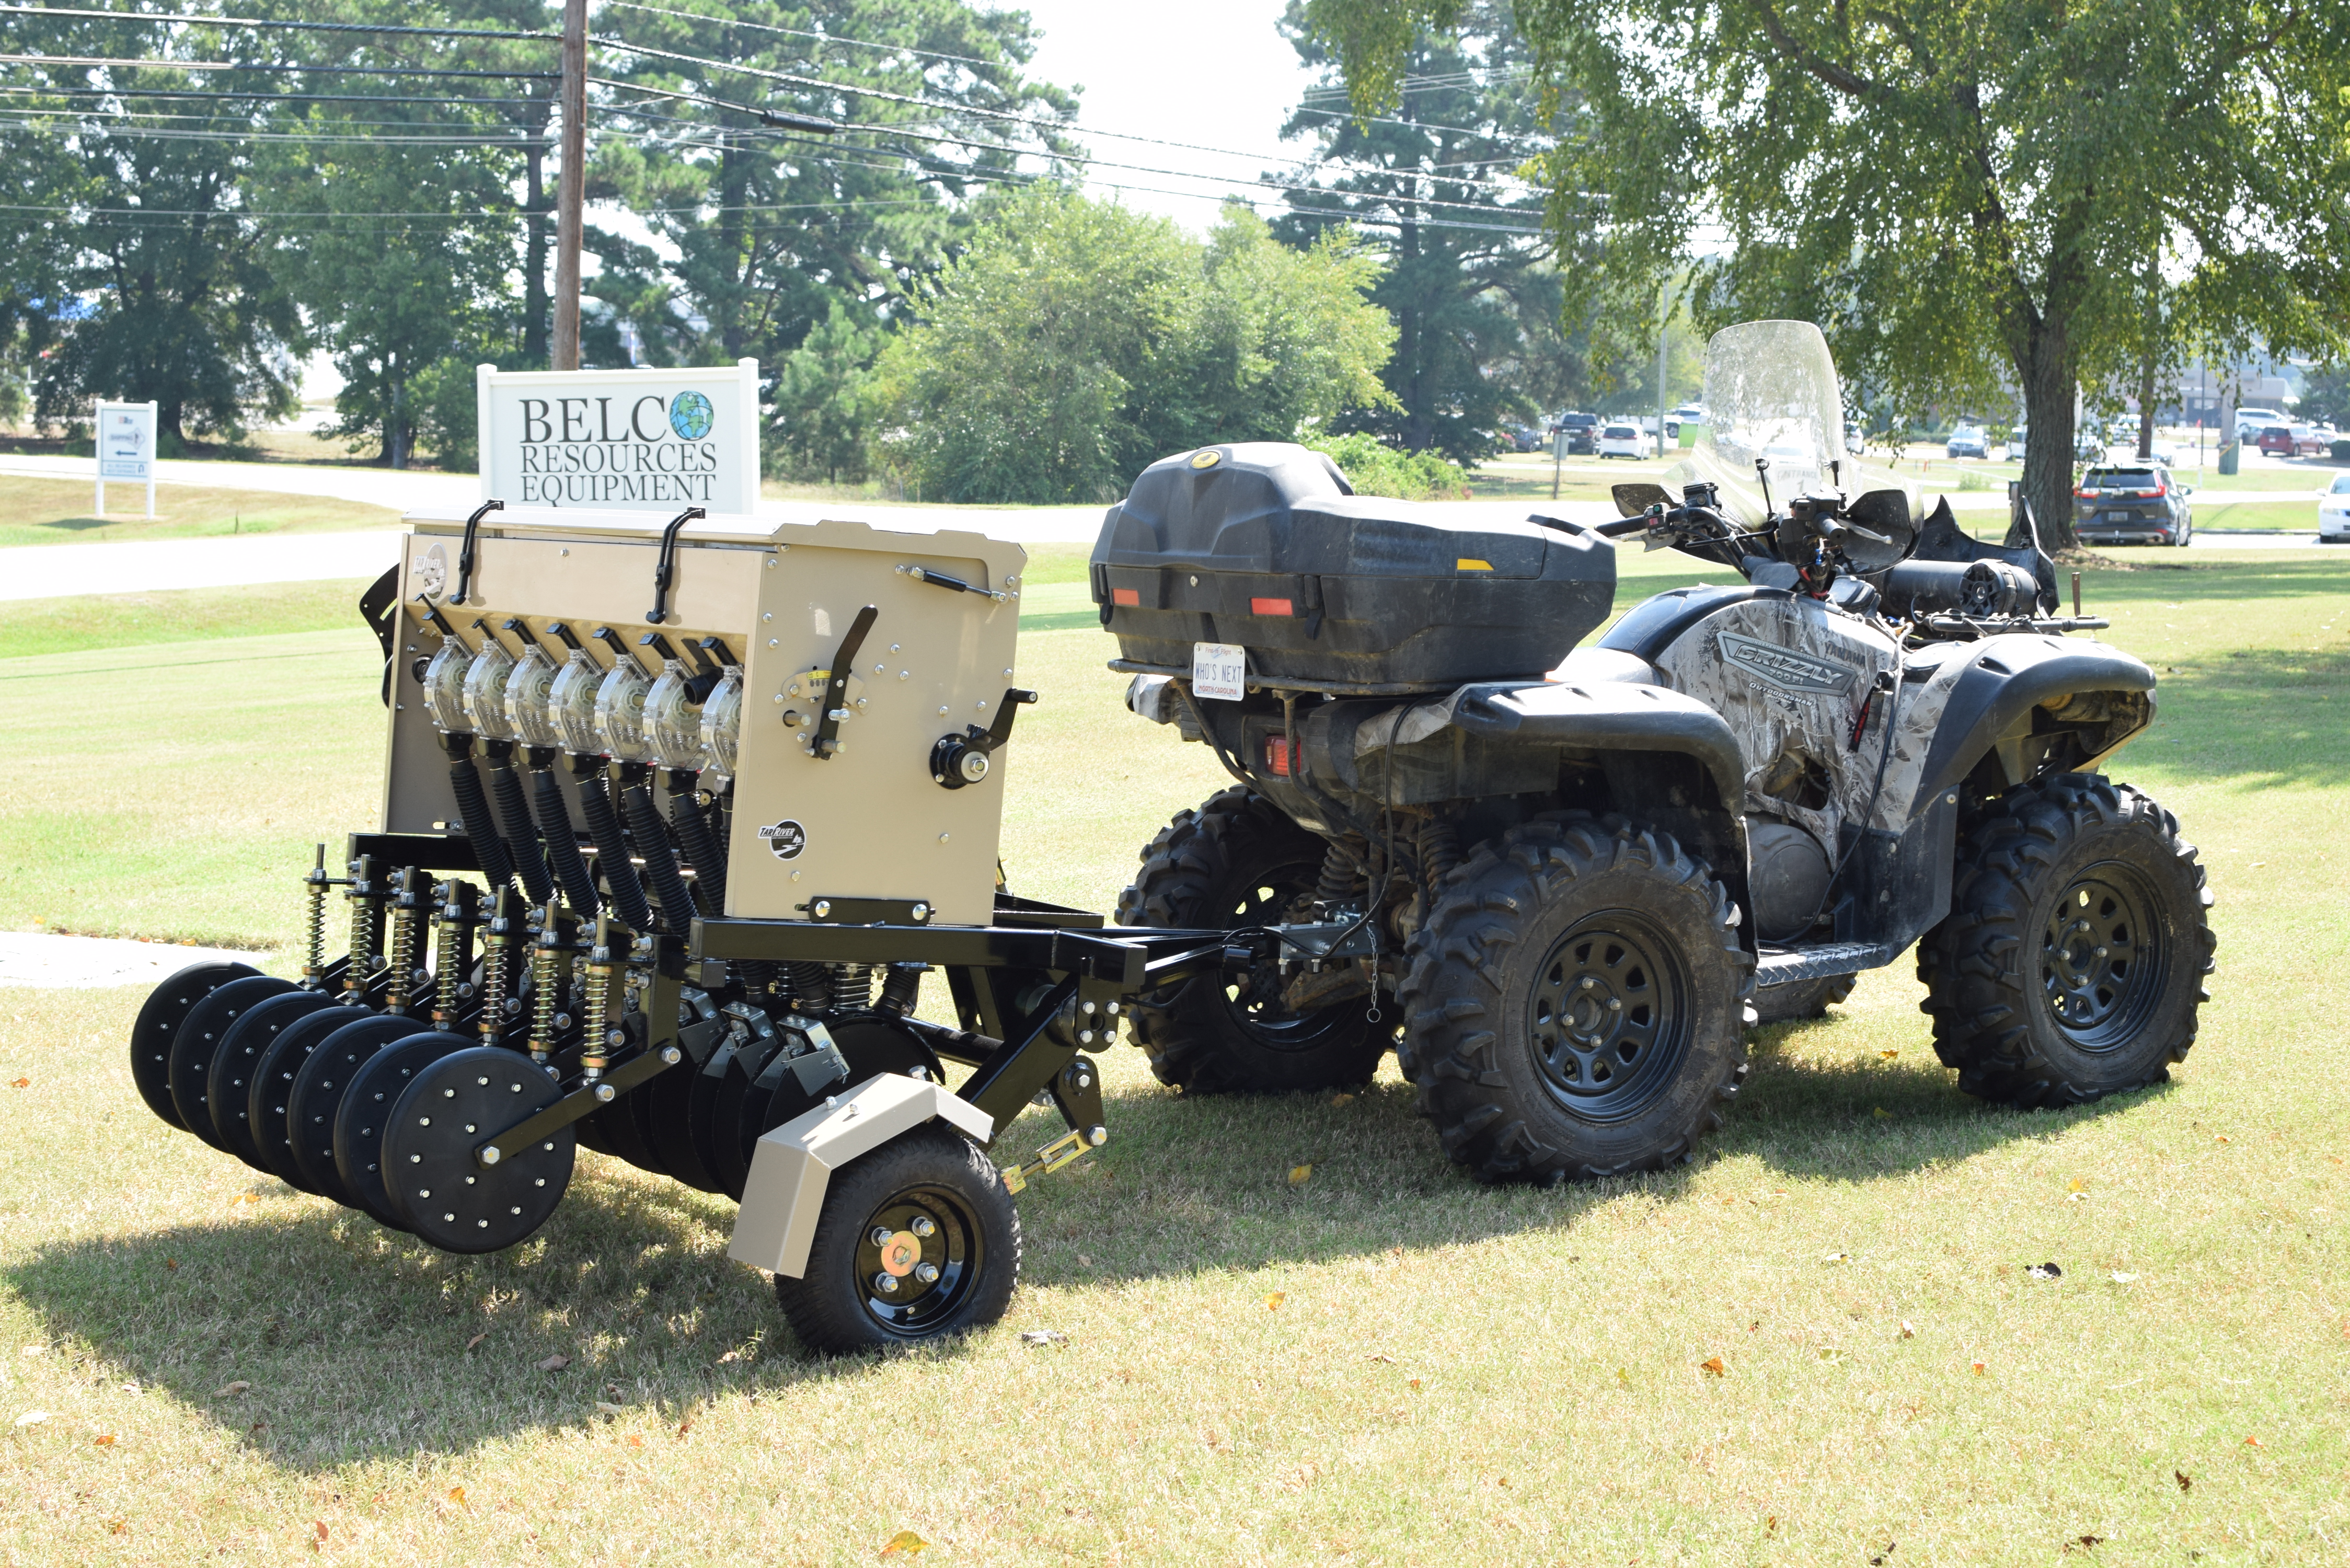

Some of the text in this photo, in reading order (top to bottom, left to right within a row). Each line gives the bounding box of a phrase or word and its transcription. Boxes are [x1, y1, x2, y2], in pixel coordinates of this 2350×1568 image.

[520, 443, 716, 473] RESOURCES
[521, 474, 717, 507] EQUIPMENT
[1734, 644, 1844, 685] GRIZZLY
[1824, 642, 1865, 667] YAMAHA
[1195, 662, 1242, 683] WHO'S NEXT
[1214, 687, 1237, 695] CAROLINA
[1748, 682, 1813, 706] OUTDOORSMAN
[759, 827, 795, 837] TAR RIVER
